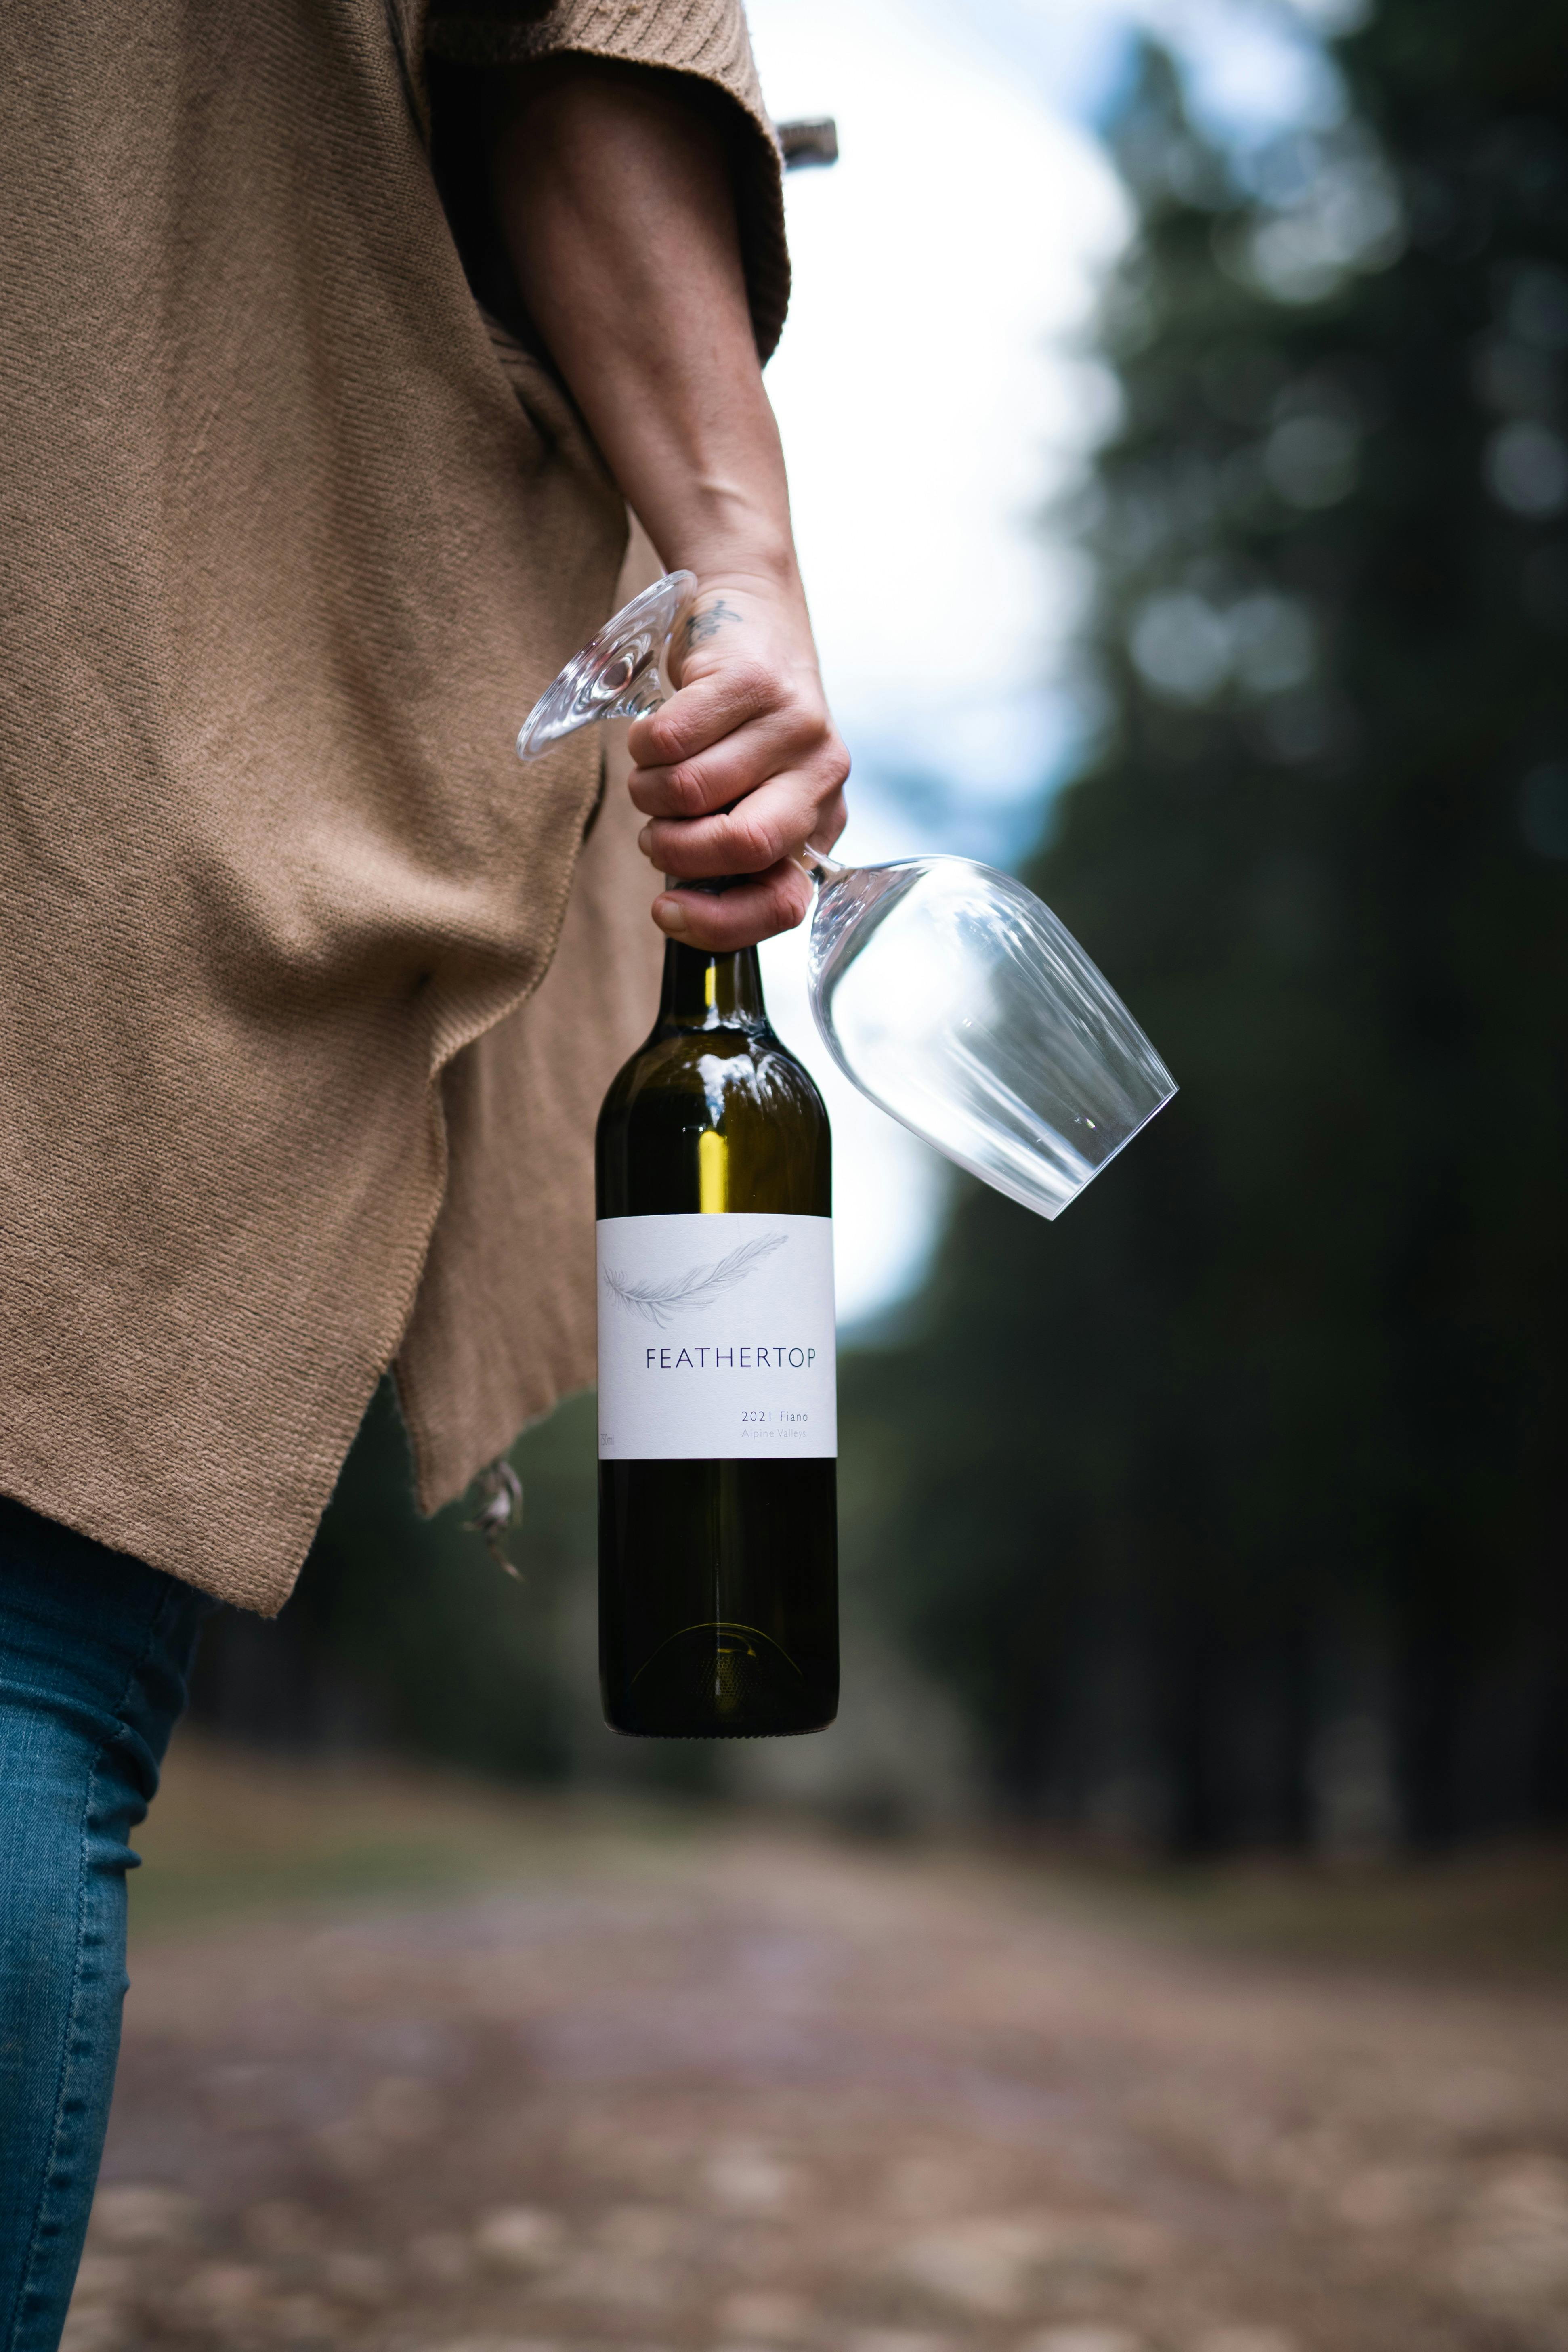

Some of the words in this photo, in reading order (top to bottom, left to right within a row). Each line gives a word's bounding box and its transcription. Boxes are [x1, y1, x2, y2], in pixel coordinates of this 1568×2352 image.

[647, 1347, 816, 1369] FEATHERTOP
[742, 1411, 771, 1422] 2021
[780, 1411, 808, 1422] Fiano
[742, 1429, 774, 1440] Alpine
[777, 1429, 806, 1440] Valleys
